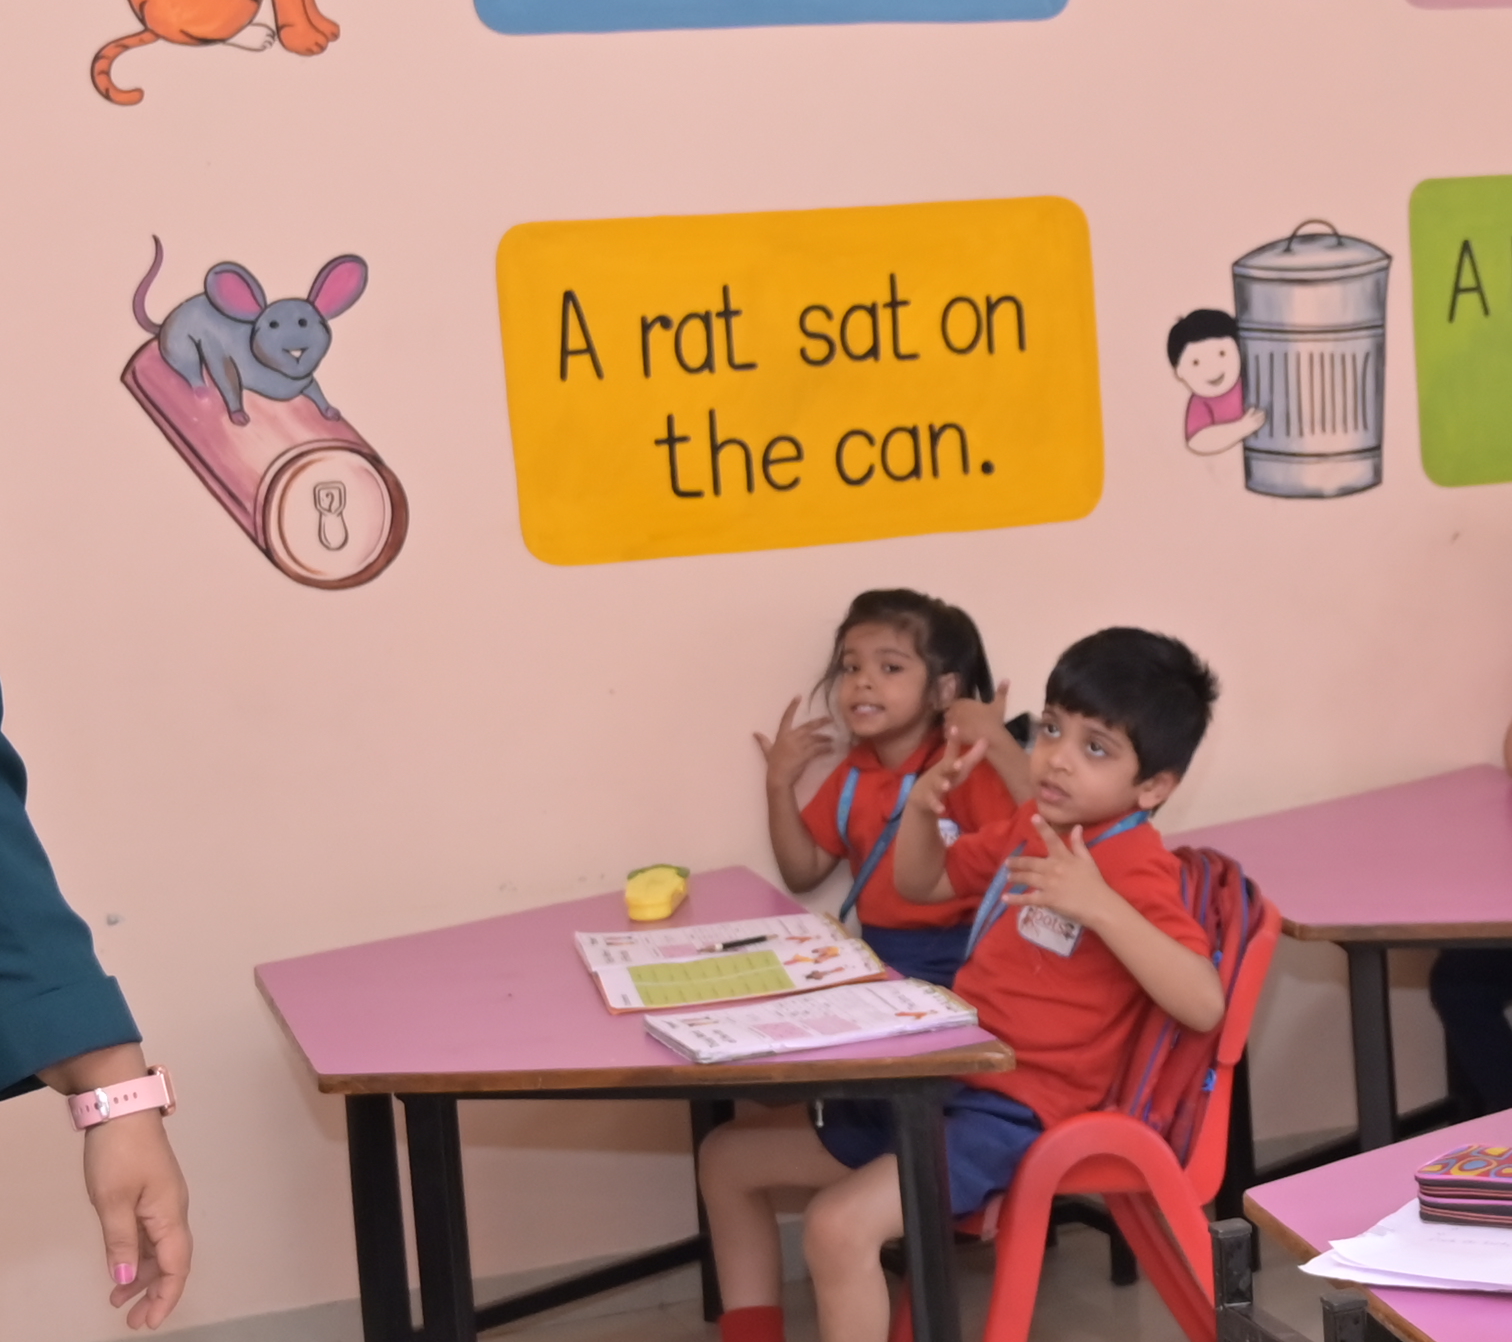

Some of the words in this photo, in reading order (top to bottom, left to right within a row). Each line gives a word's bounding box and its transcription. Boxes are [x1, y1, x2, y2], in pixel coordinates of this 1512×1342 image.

[1449, 240, 1490, 322] A
[560, 290, 603, 381] A
[641, 285, 757, 378] rat
[799, 274, 919, 367] sat
[941, 295, 1026, 355] on
[655, 409, 804, 498] the
[835, 423, 994, 486] can.
